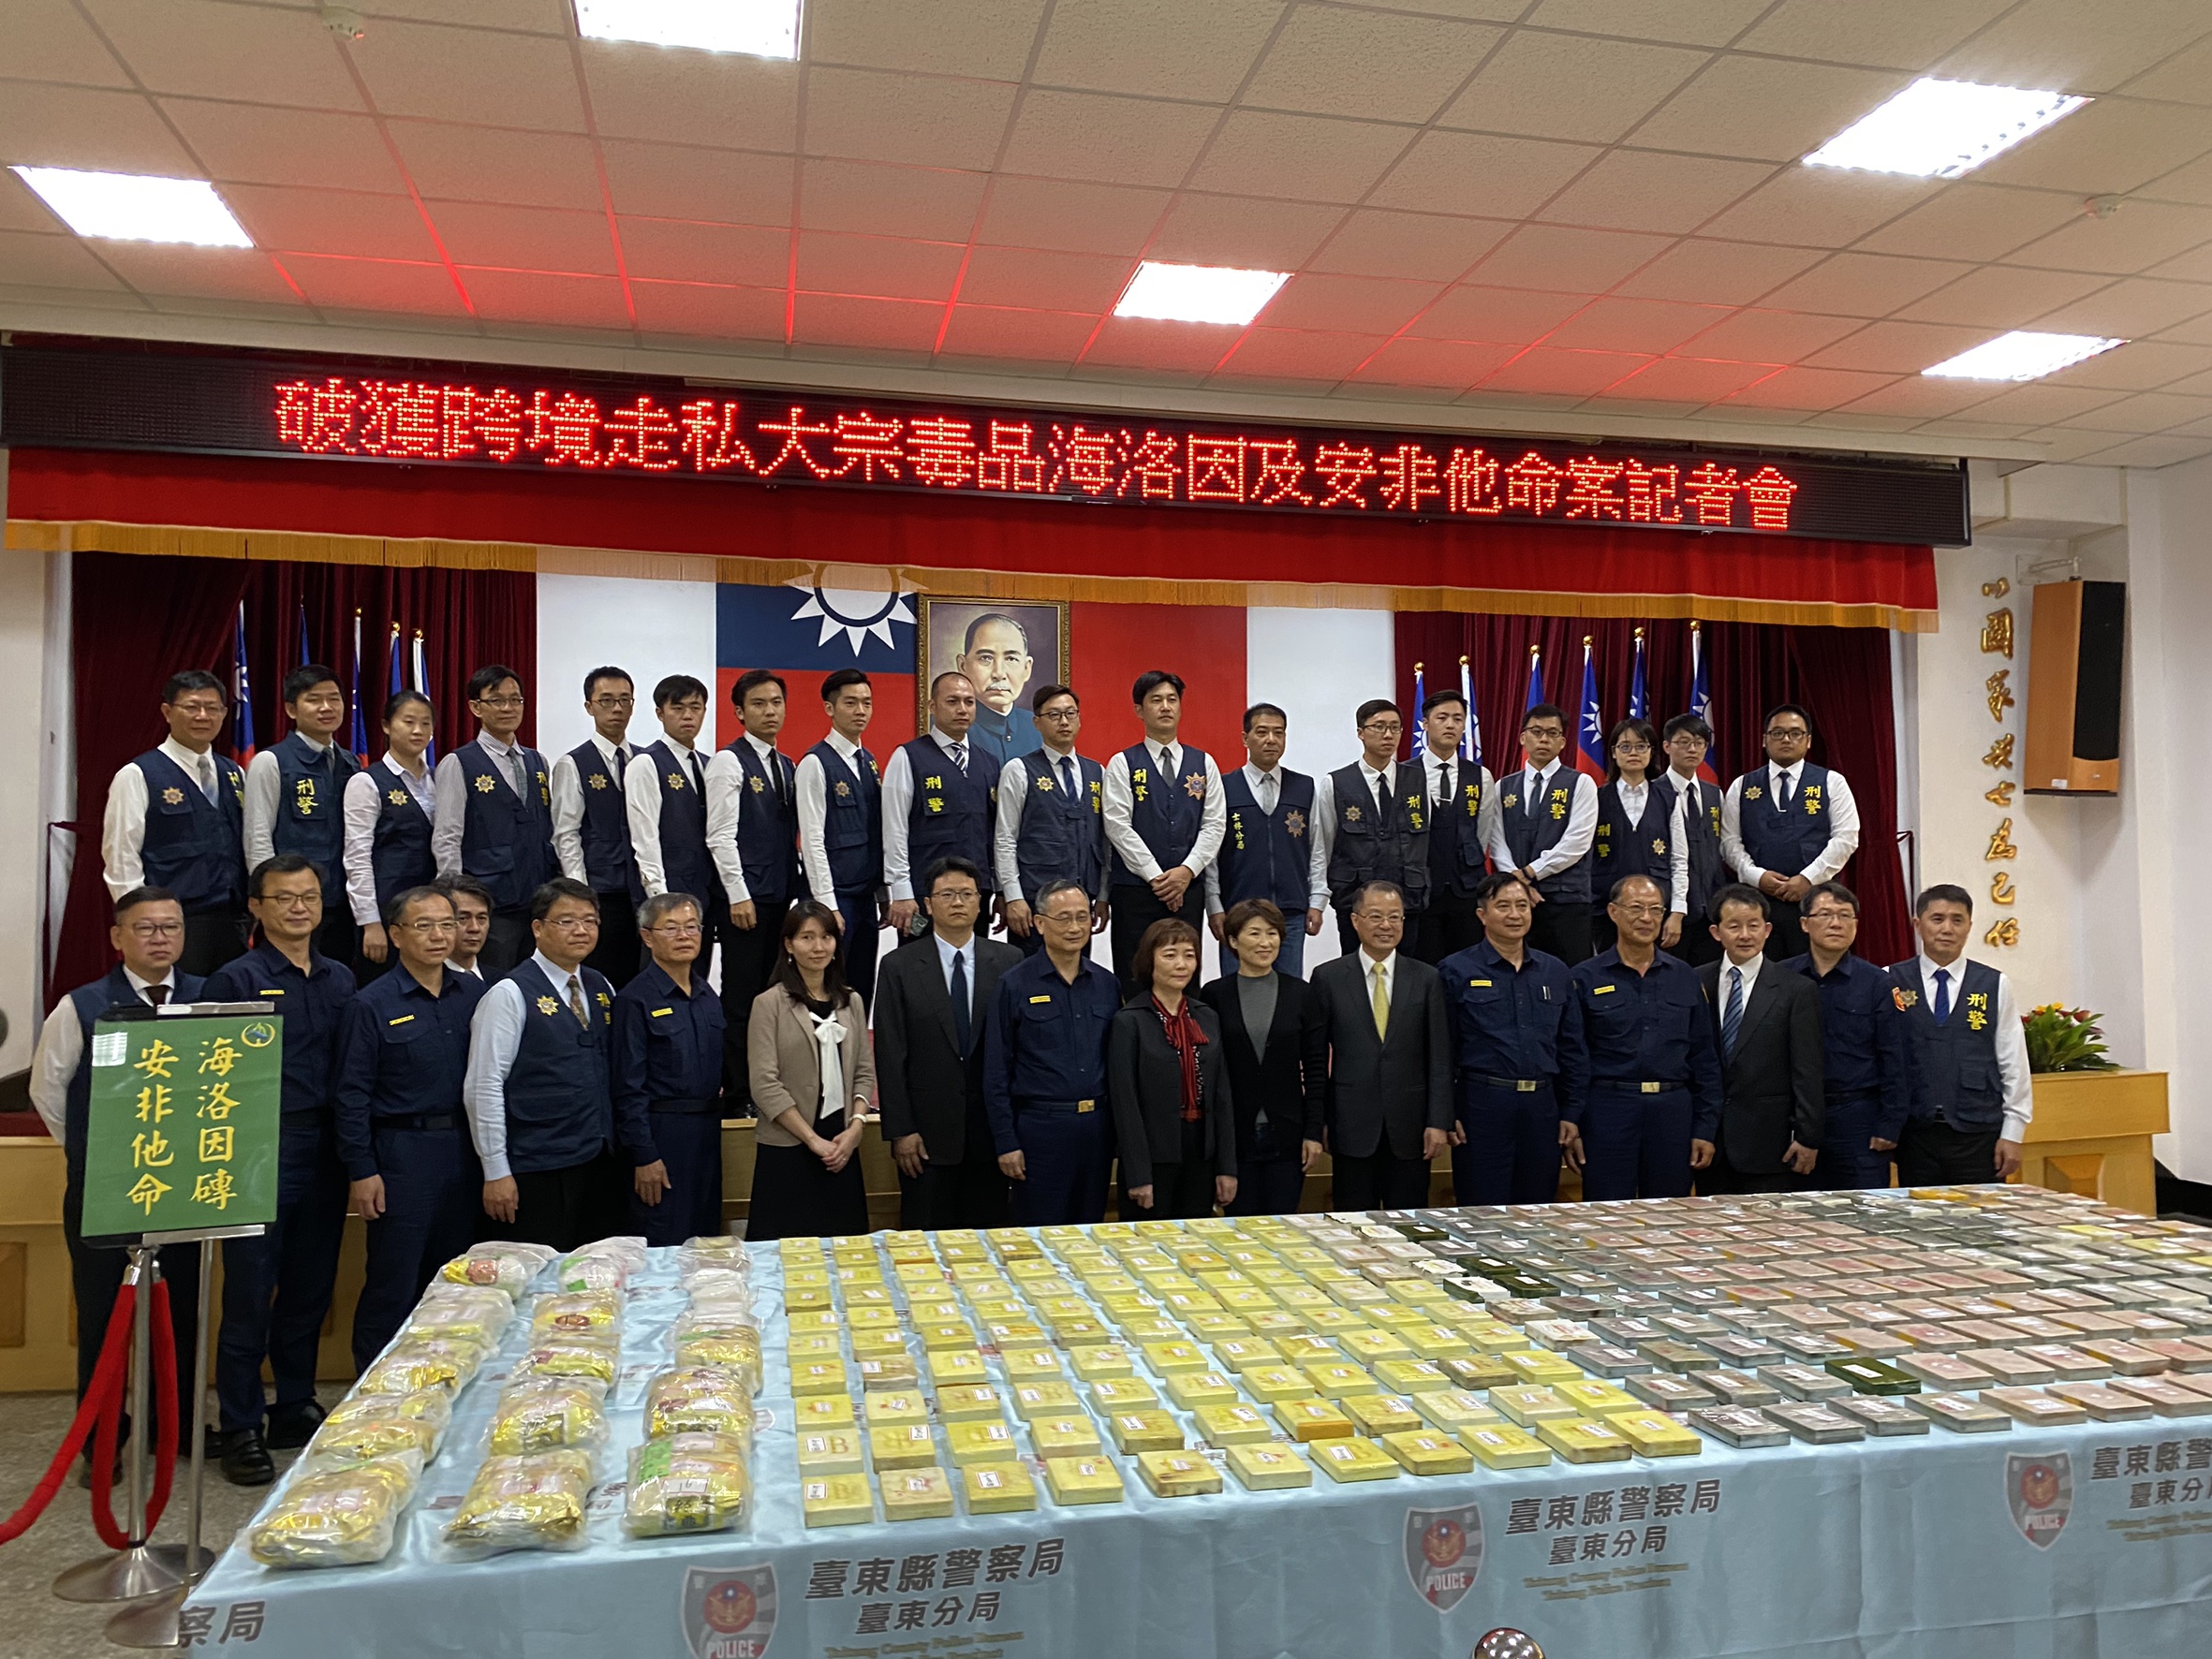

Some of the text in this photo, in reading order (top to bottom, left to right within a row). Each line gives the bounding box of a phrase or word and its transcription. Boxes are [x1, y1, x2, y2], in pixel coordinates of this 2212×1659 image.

[273, 376, 1798, 531] 破獲跨境走私大宗毒品海洛因及安非他命案記者會
[296, 778, 318, 815] 刑警
[924, 775, 944, 813] 刑警
[1133, 768, 1148, 801] 刑警
[1465, 785, 1480, 816] 刑警
[1804, 785, 1821, 815] 刑警
[1407, 794, 1423, 830] 刑警
[1550, 787, 1569, 820] 刑警
[1597, 823, 1611, 858] 刑警
[1967, 992, 1987, 1030] 刑警
[125, 1039, 179, 1216] 安非他命
[190, 1037, 243, 1210] 海洛因磚
[1505, 1479, 1721, 1535] 臺東縣警察局
[2129, 1477, 2212, 1508] 臺東分
[1547, 1525, 1668, 1566] 臺東分局
[805, 1537, 1065, 1600] 臺東縣警察局
[1425, 1572, 1467, 1592] POLICE
[855, 1591, 1000, 1635] 臺東分局
[706, 1638, 755, 1659] POLICE
